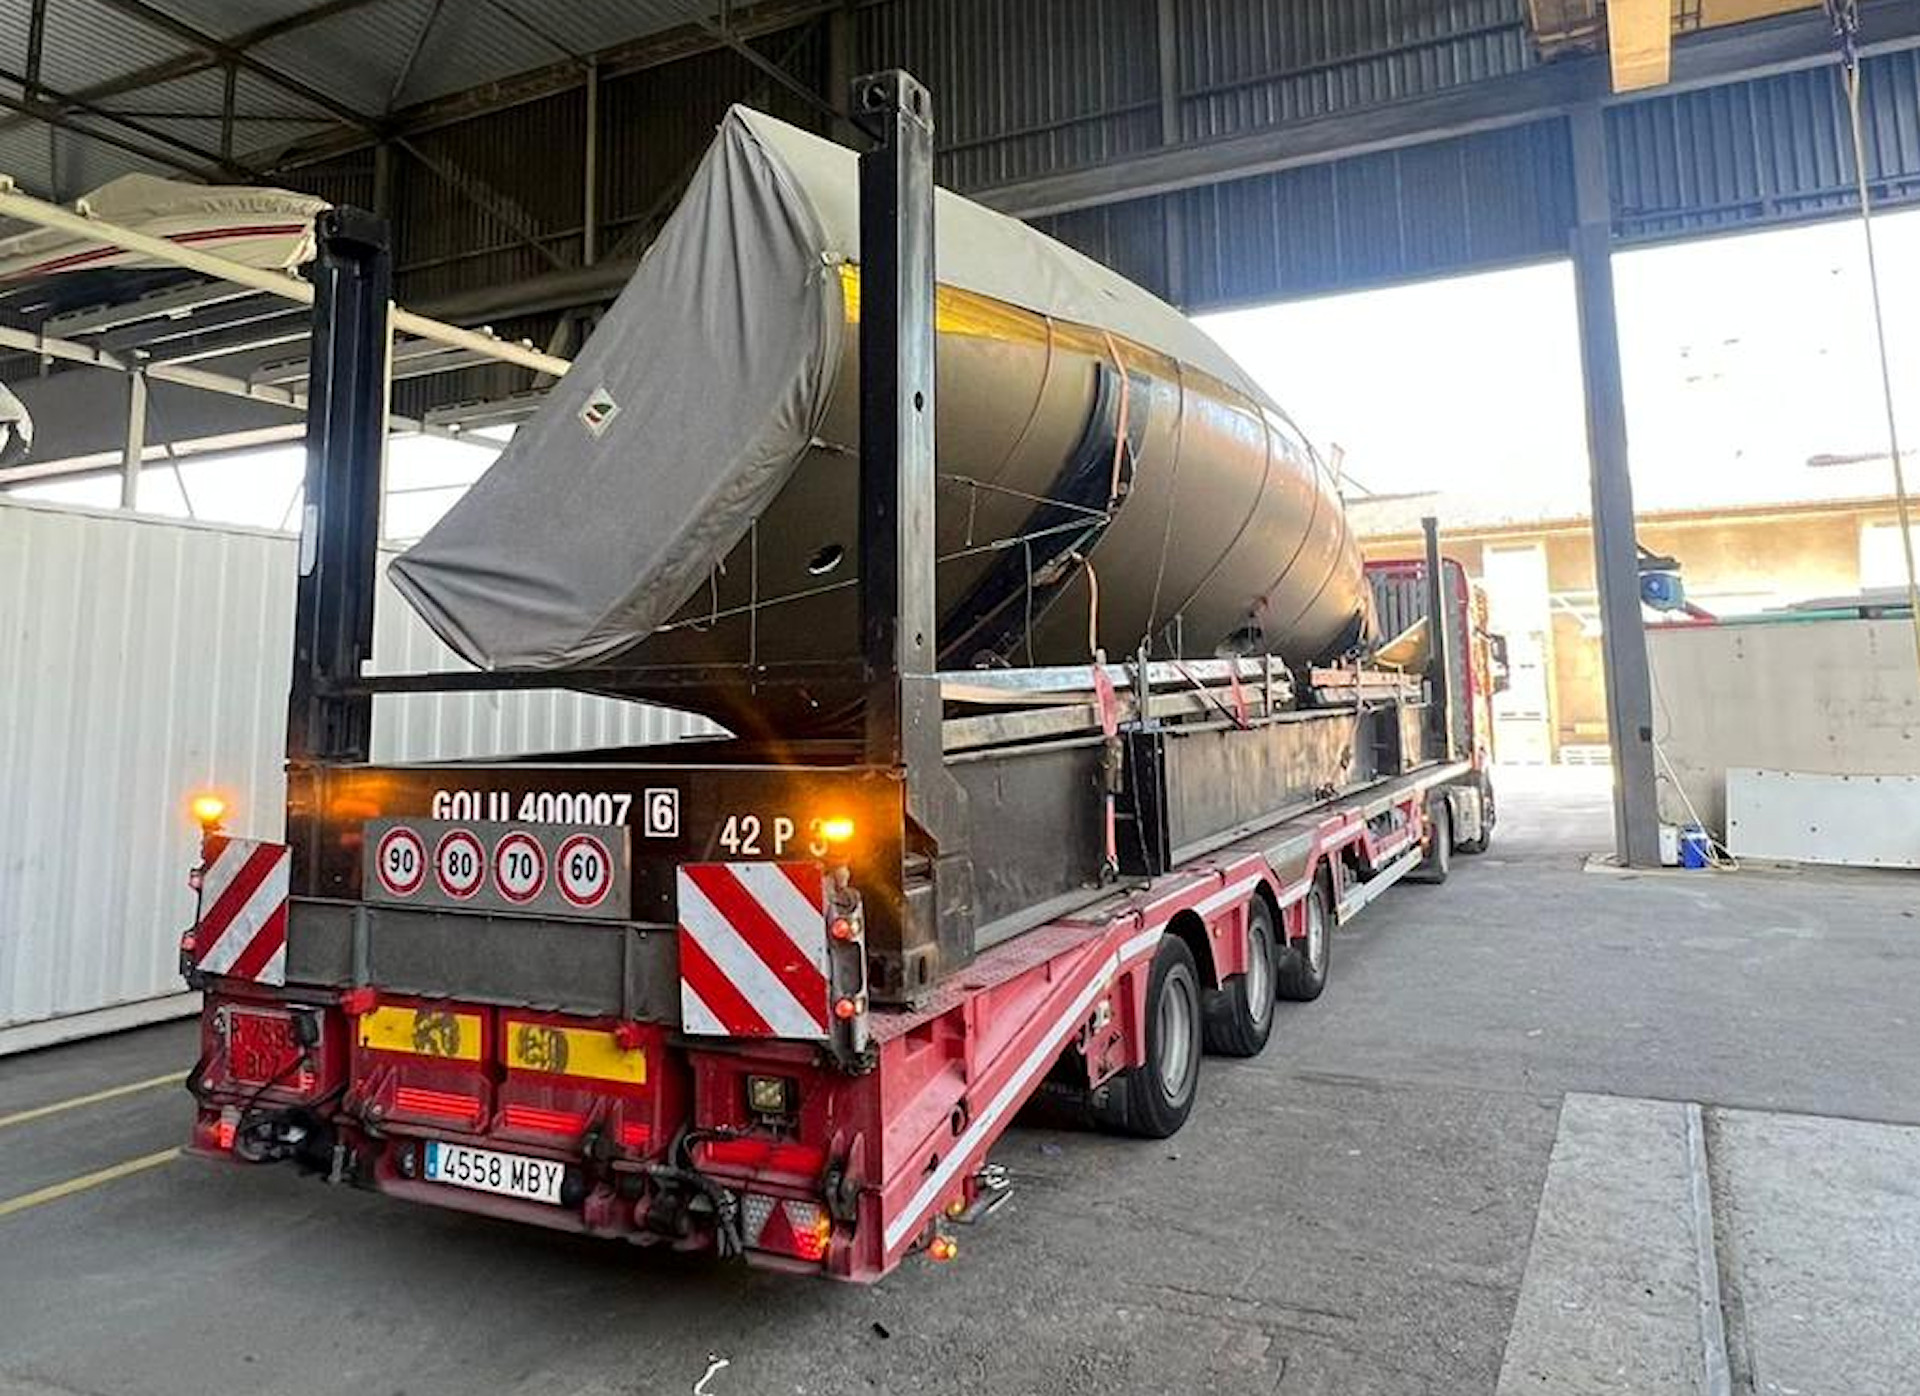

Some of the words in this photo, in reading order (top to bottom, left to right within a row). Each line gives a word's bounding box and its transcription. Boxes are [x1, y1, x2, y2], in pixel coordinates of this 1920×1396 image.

[518, 791, 633, 827] 400007
[651, 792, 675, 833] 6
[719, 815, 761, 855] 42
[774, 817, 795, 855] P
[389, 847, 414, 873] 90
[449, 851, 472, 877] 80
[508, 853, 533, 880] 70
[571, 854, 597, 882] 60
[444, 1149, 502, 1187] 4558
[511, 1159, 557, 1196] MBY
